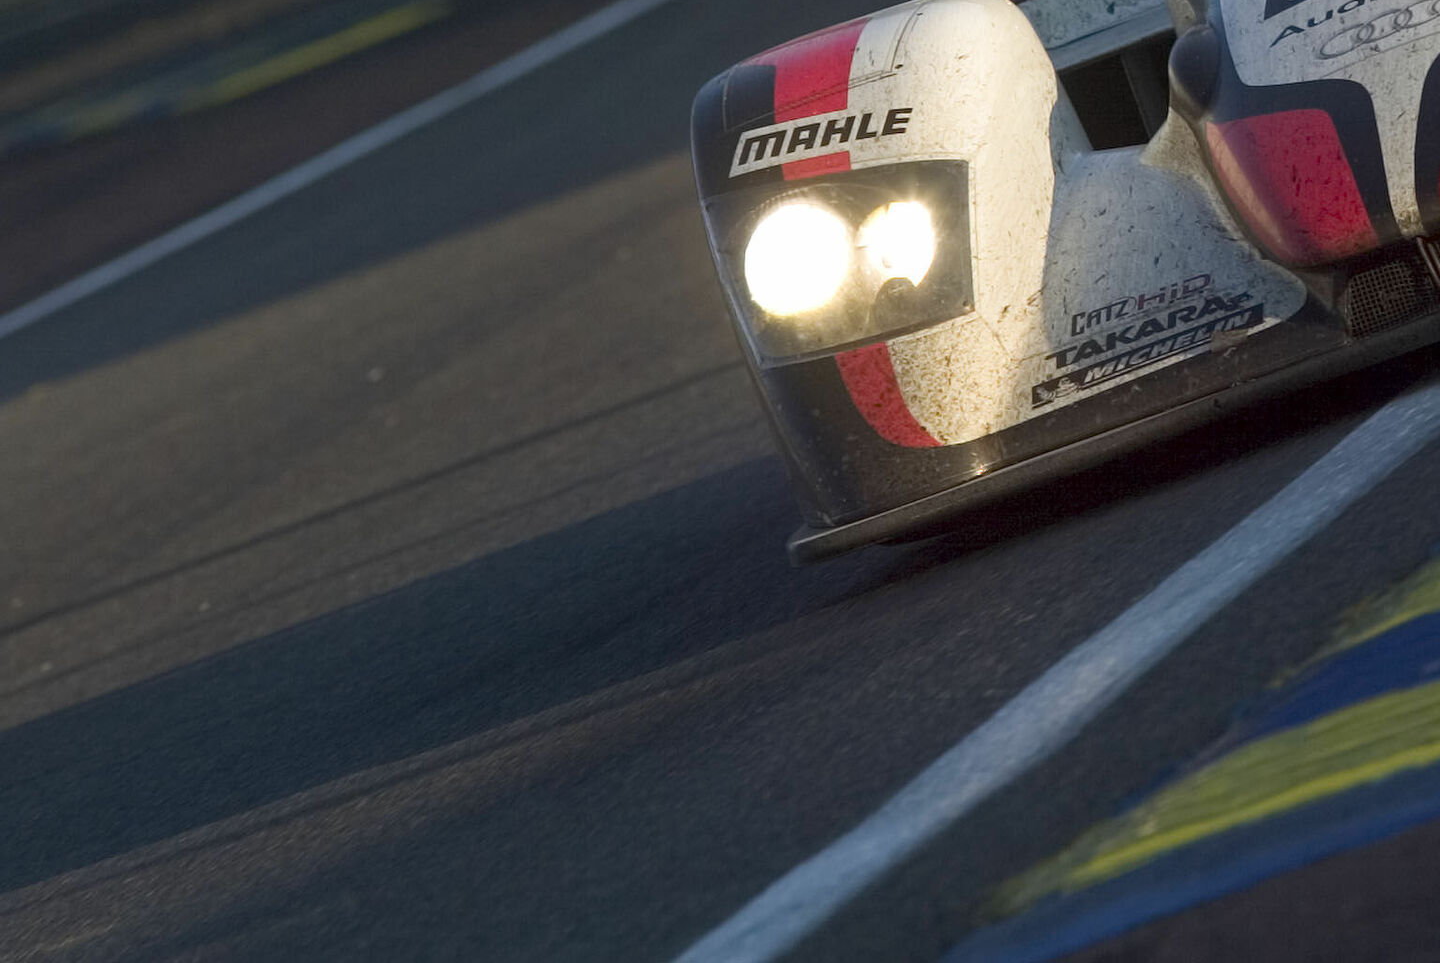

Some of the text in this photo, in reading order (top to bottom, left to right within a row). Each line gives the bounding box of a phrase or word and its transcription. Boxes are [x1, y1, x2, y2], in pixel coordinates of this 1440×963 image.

[738, 107, 914, 167] MAHLE
[1045, 295, 1232, 369] TAKARA
[1084, 312, 1251, 384] MICHELIN
